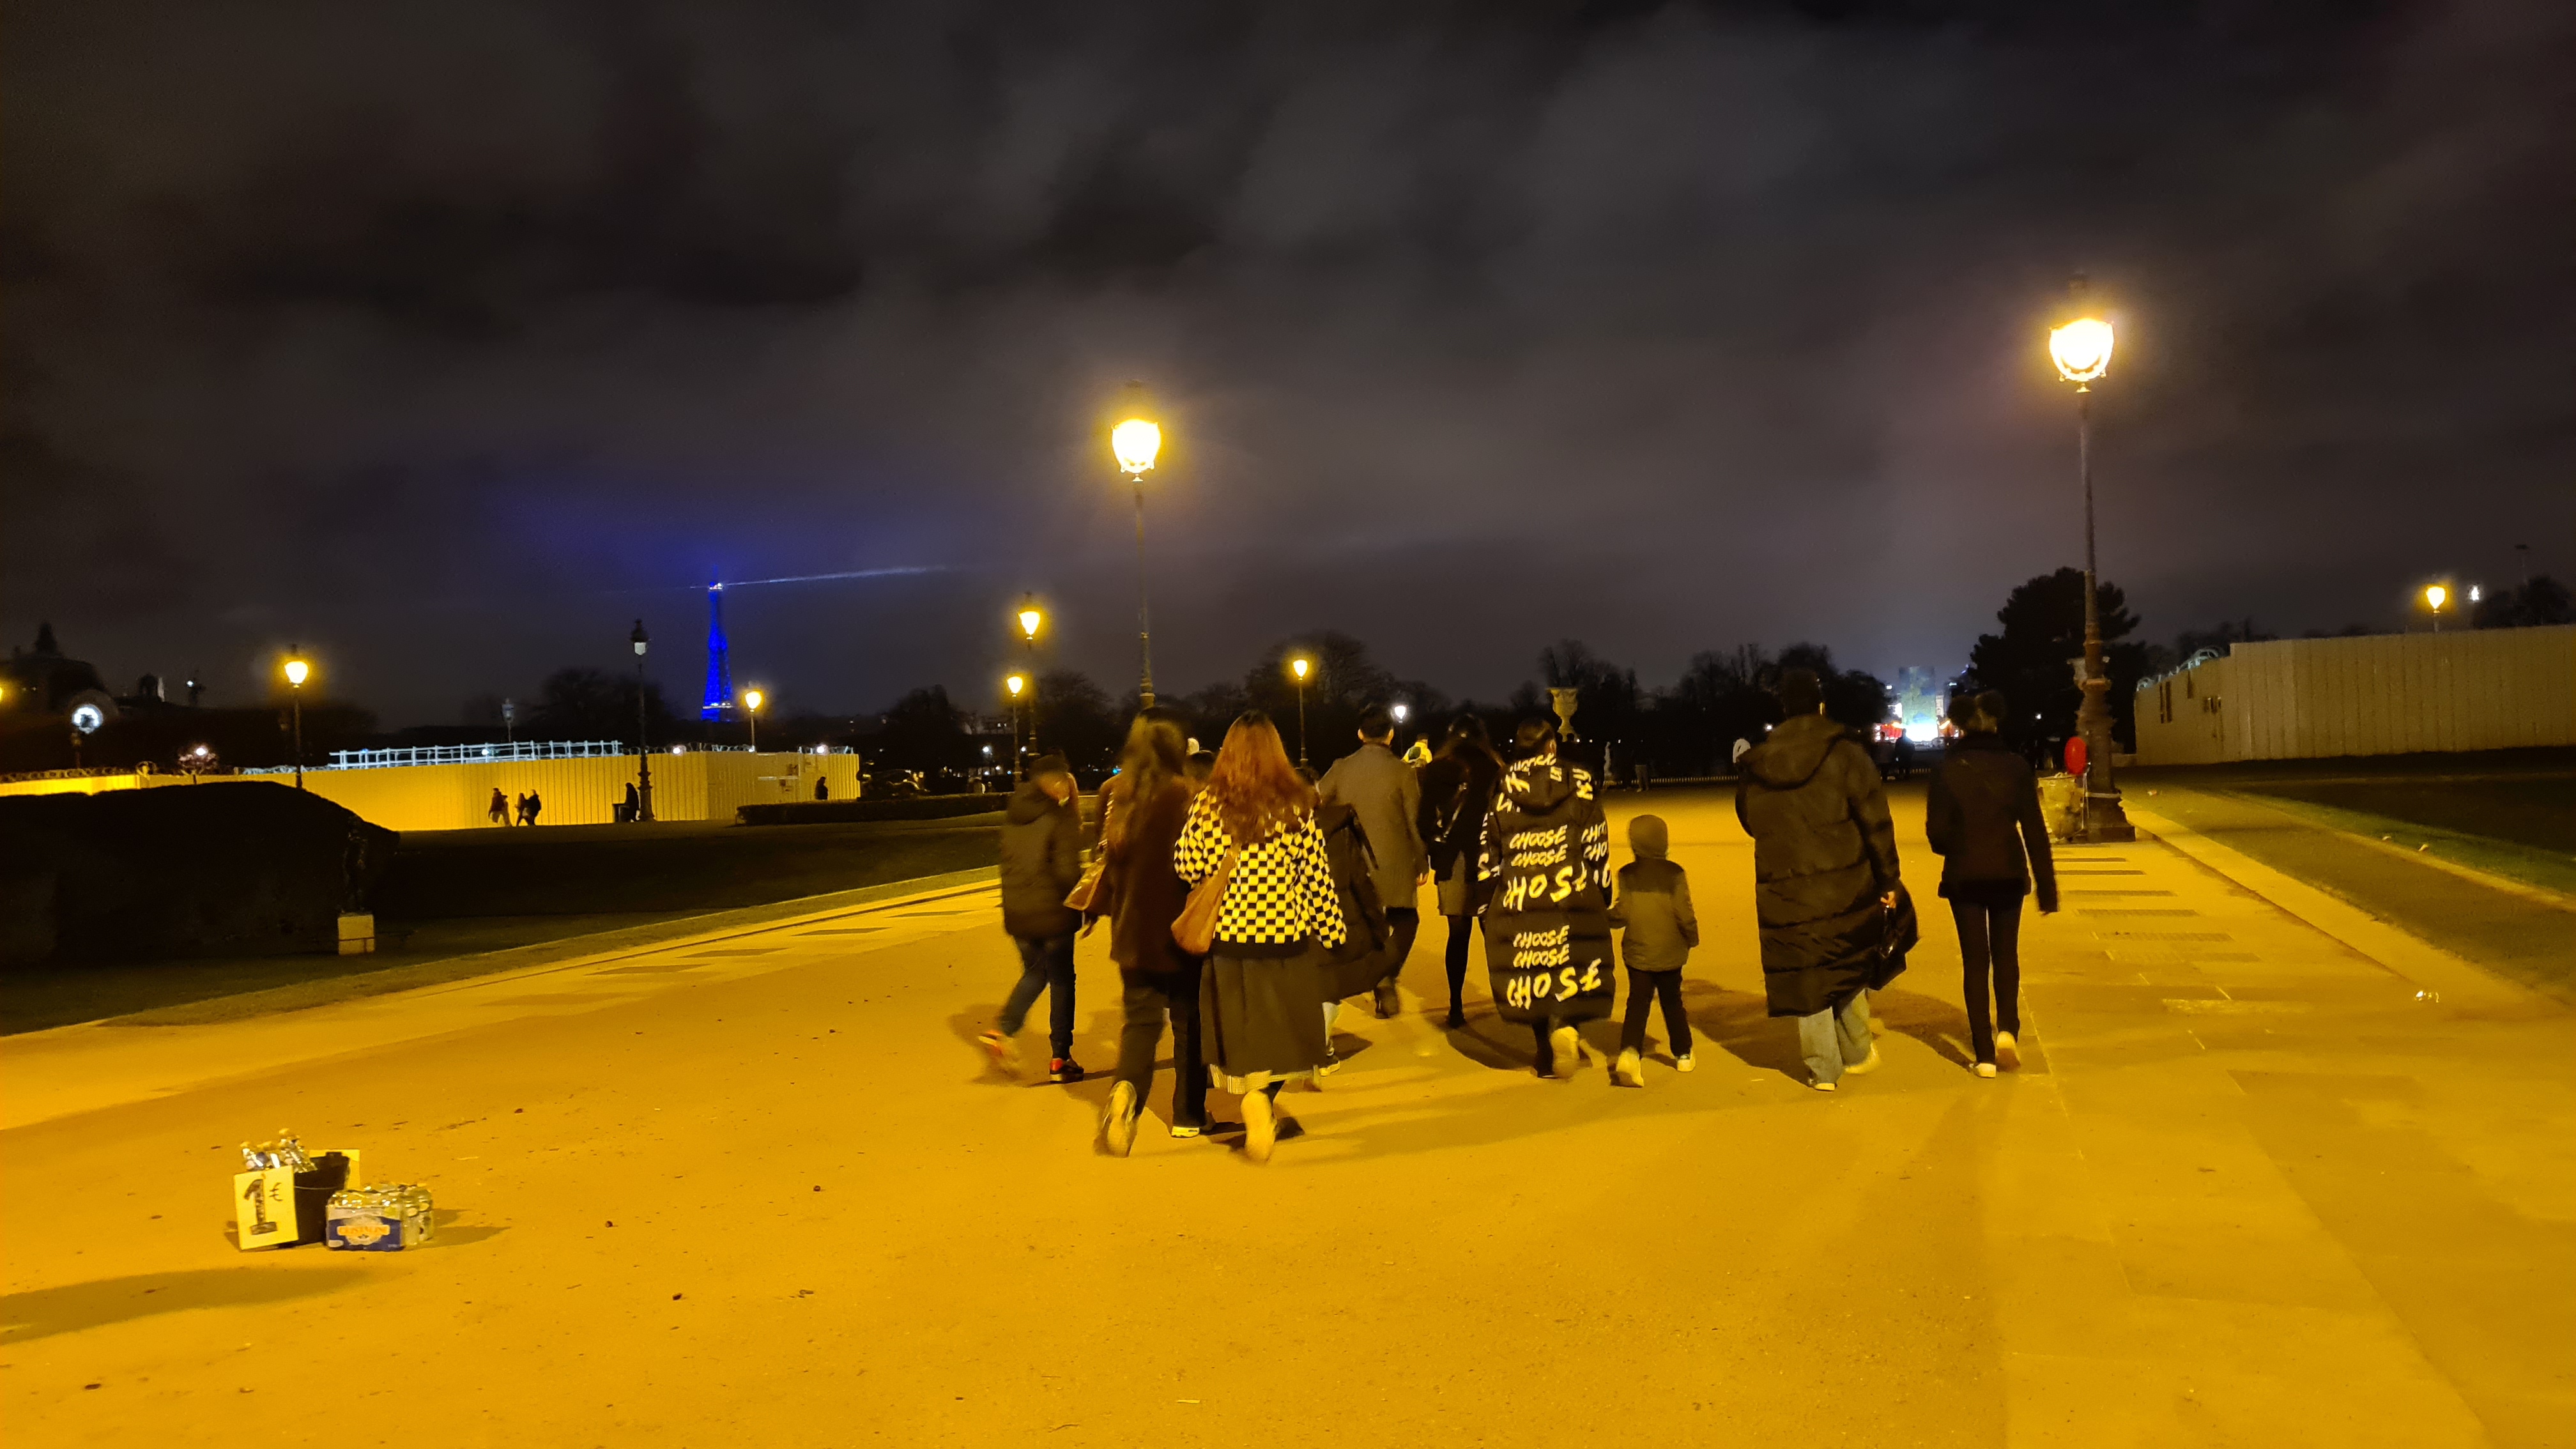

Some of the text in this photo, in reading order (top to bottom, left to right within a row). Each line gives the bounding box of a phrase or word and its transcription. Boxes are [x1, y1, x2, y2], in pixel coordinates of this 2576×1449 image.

[1510, 825, 1567, 850] CHOOSE
[1511, 844, 1568, 868] CHOOSE
[1513, 925, 1570, 948] CHOOSE
[1513, 944, 1570, 969] CHOOSE
[1506, 958, 1602, 1010] CHOSE
